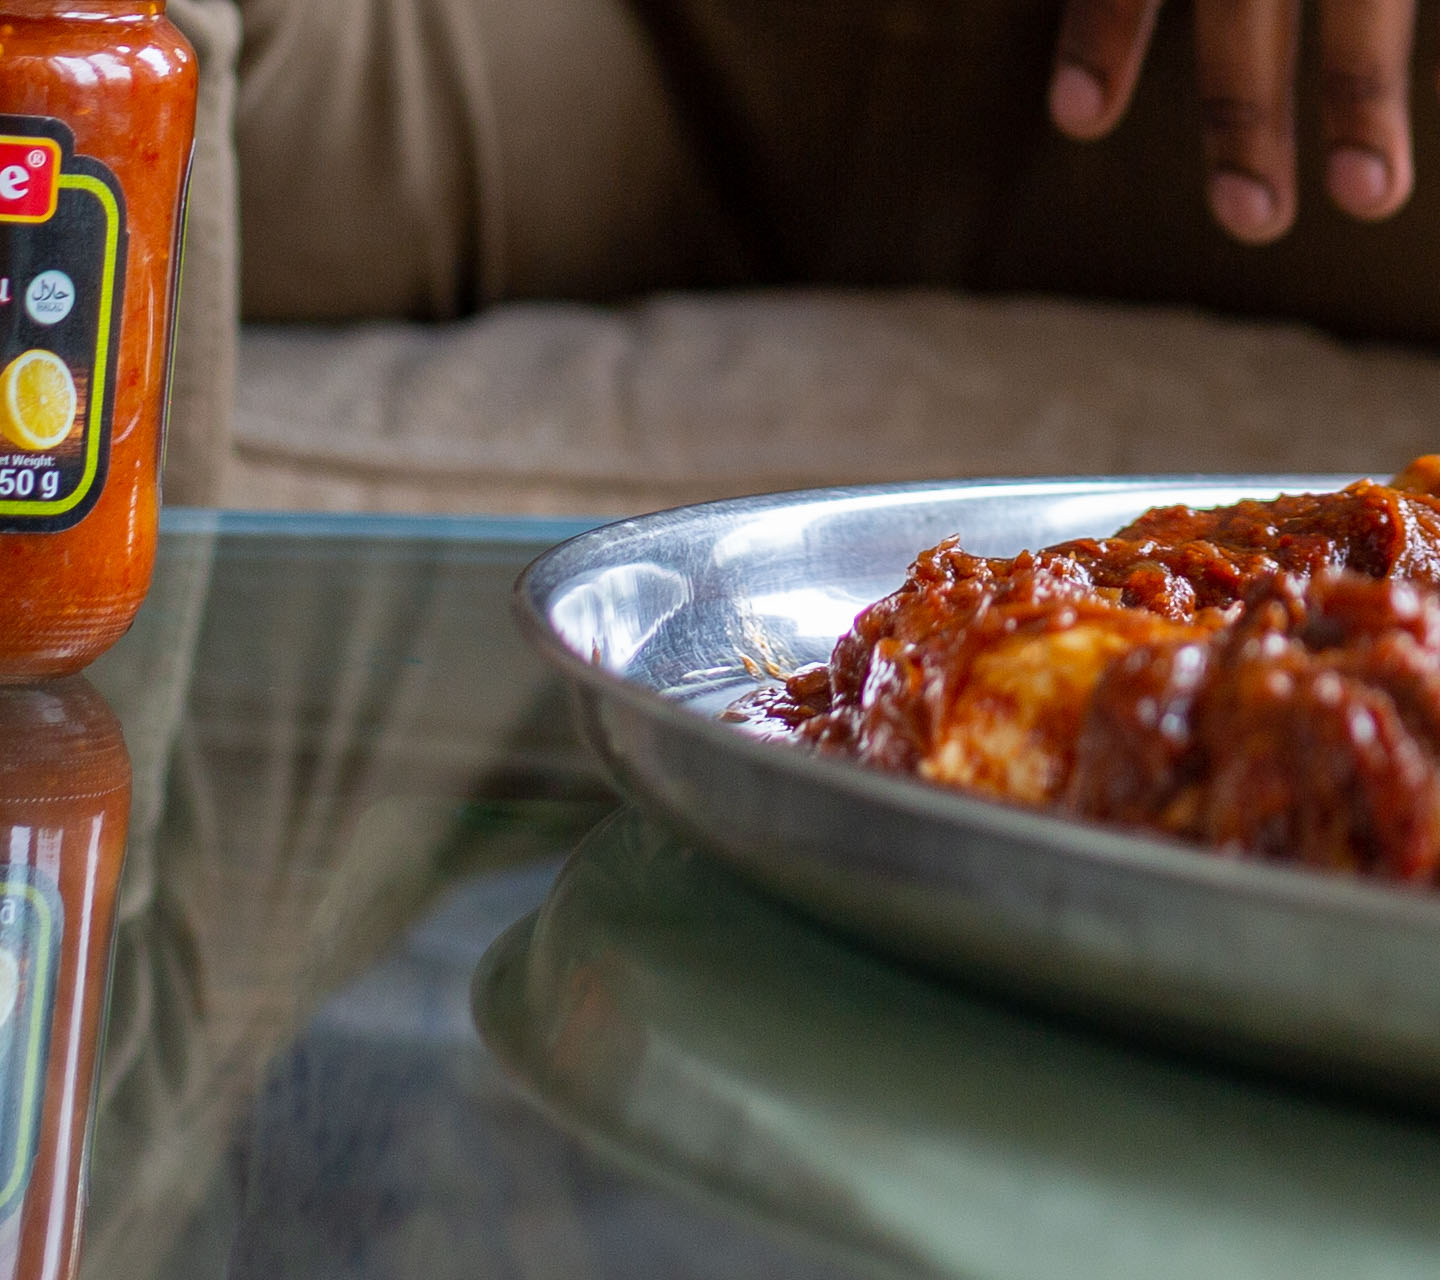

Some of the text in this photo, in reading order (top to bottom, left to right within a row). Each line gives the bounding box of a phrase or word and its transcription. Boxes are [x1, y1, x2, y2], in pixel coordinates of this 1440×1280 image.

[31, 279, 69, 301] حلال
[12, 454, 56, 469] Weight:
[41, 470, 60, 499] g
